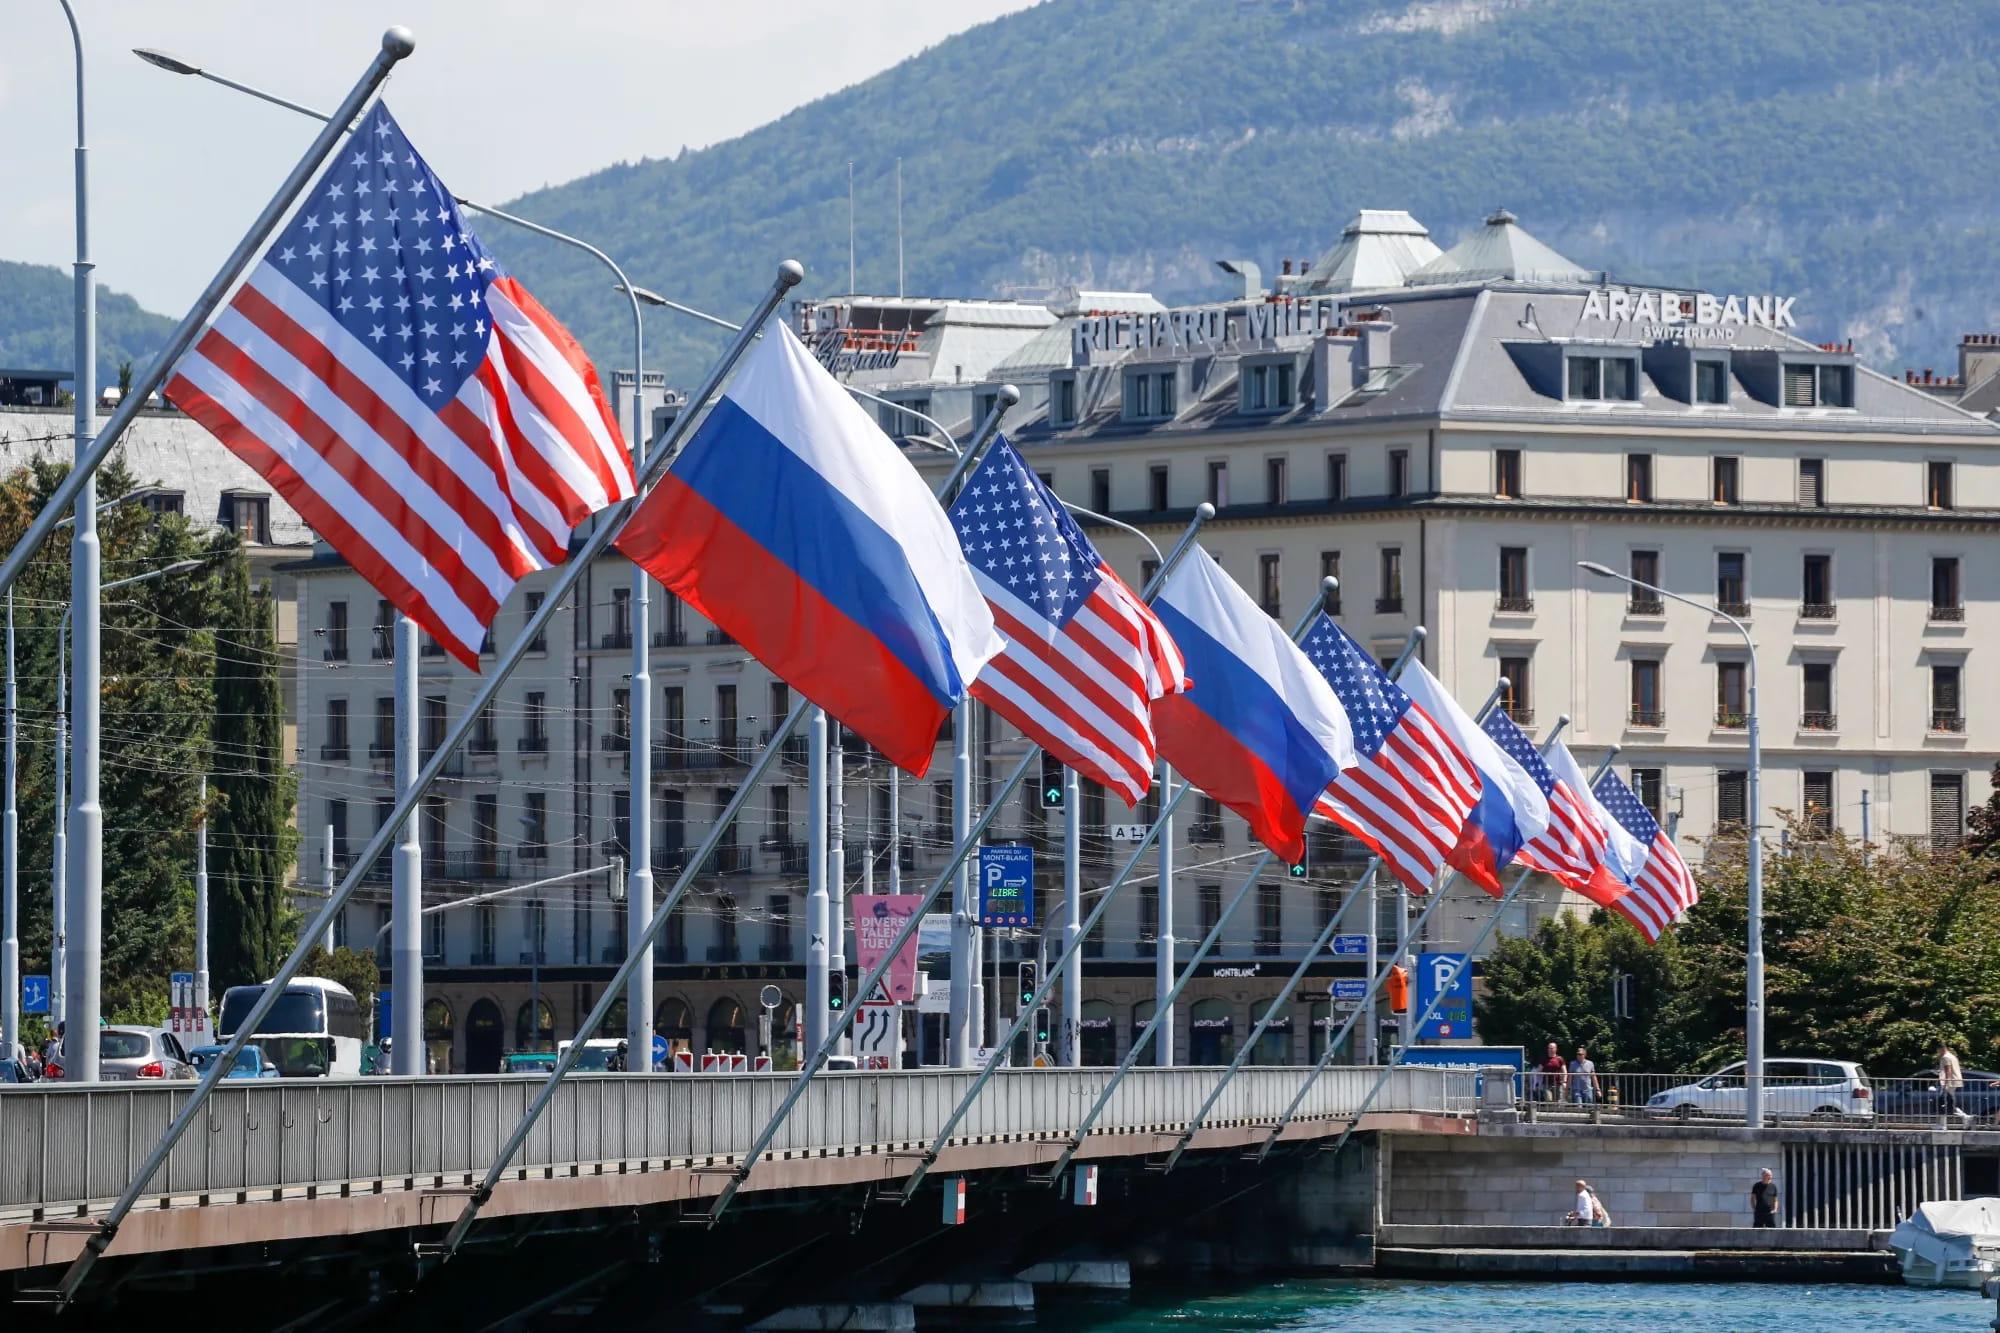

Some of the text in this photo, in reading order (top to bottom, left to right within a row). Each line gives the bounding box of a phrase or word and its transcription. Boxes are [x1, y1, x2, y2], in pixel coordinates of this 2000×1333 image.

[1581, 290, 1797, 328] ARAB BANK
[1073, 308, 1228, 354] RICHARD
[1642, 325, 1735, 341] SWITZERLAND
[1115, 827, 1125, 838] A
[983, 854, 1029, 862] MONT-BLANC
[987, 868, 1002, 887] P
[992, 888, 1019, 897] LIBRE
[1213, 967, 1256, 978] MONTBLANC
